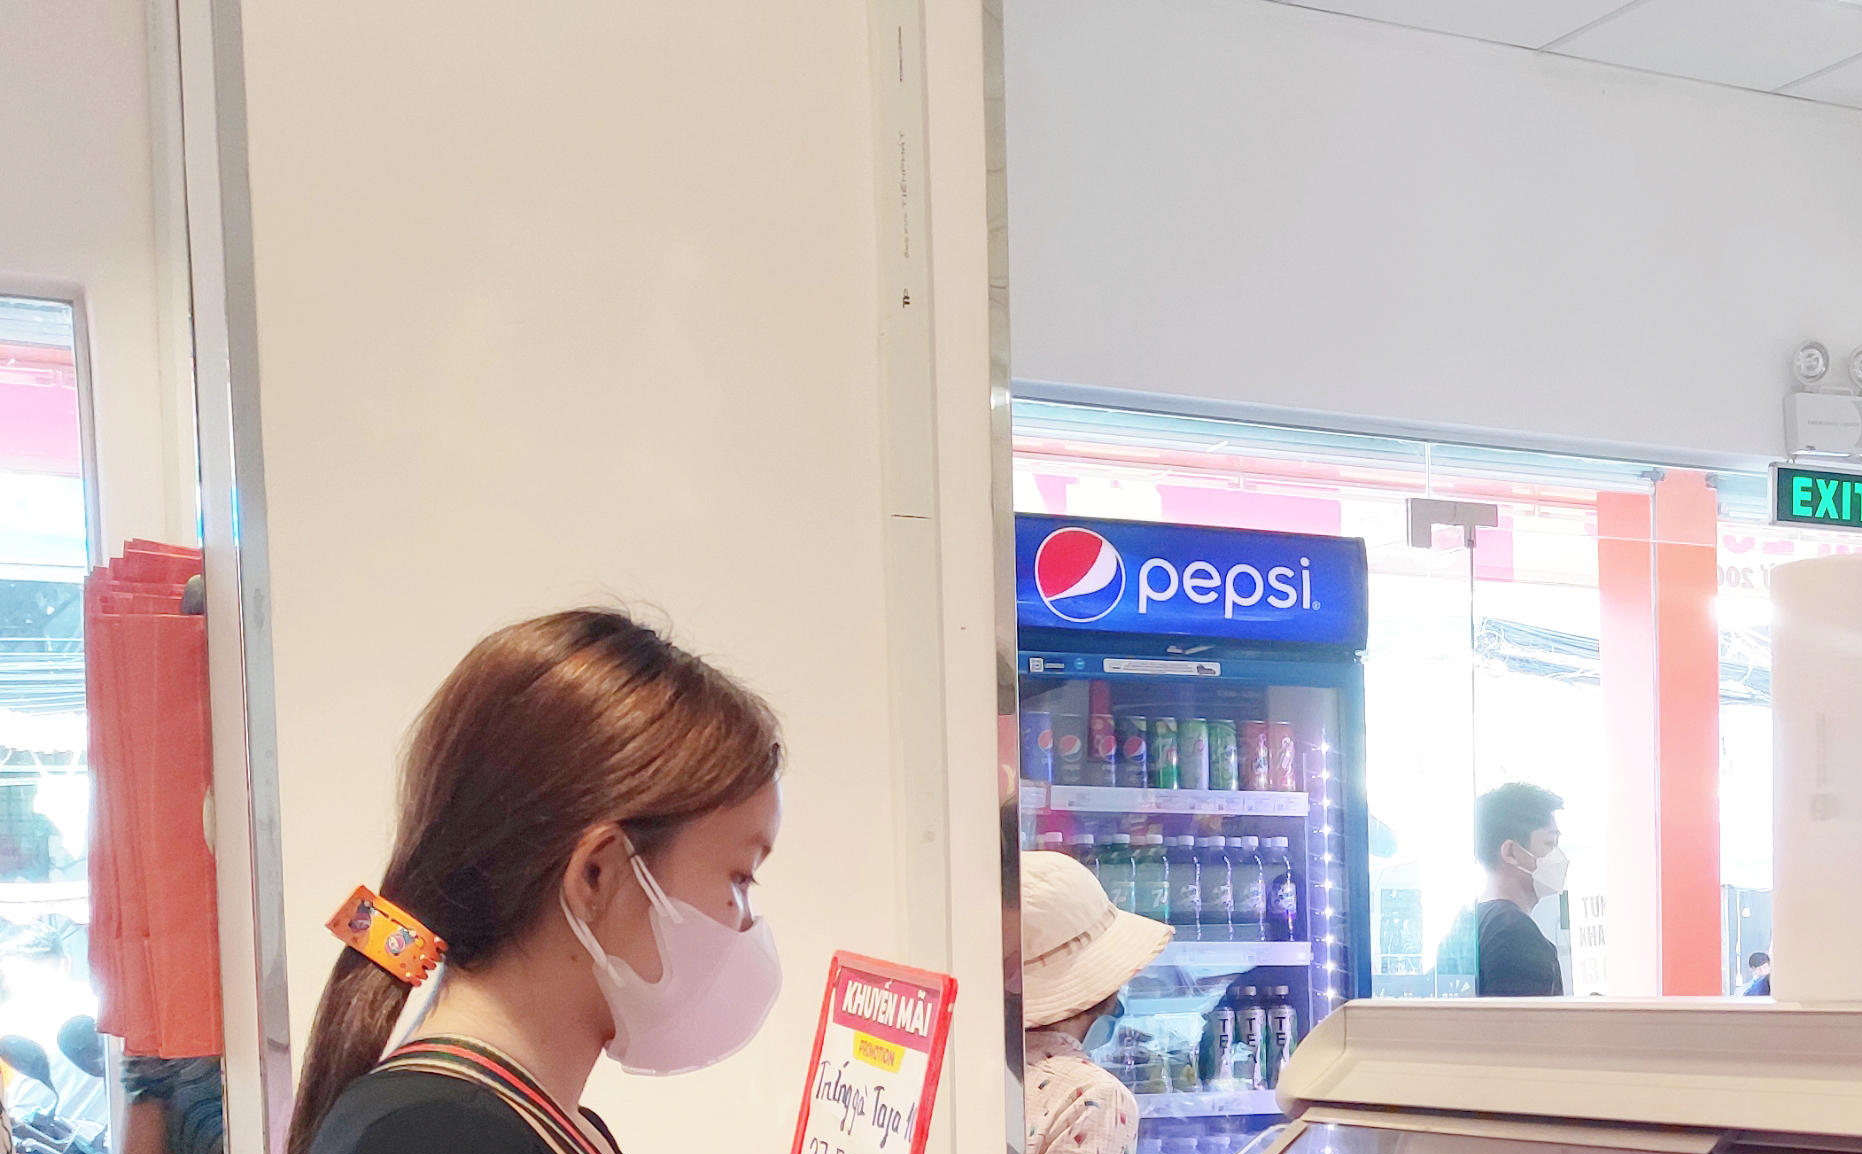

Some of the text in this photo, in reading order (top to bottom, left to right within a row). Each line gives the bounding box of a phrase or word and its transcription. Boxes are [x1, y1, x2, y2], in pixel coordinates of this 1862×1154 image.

[1138, 556, 1313, 619] pepsi
[842, 980, 933, 1037] KHUYẾN MÃI
[858, 1039, 896, 1067] PROMOTION
